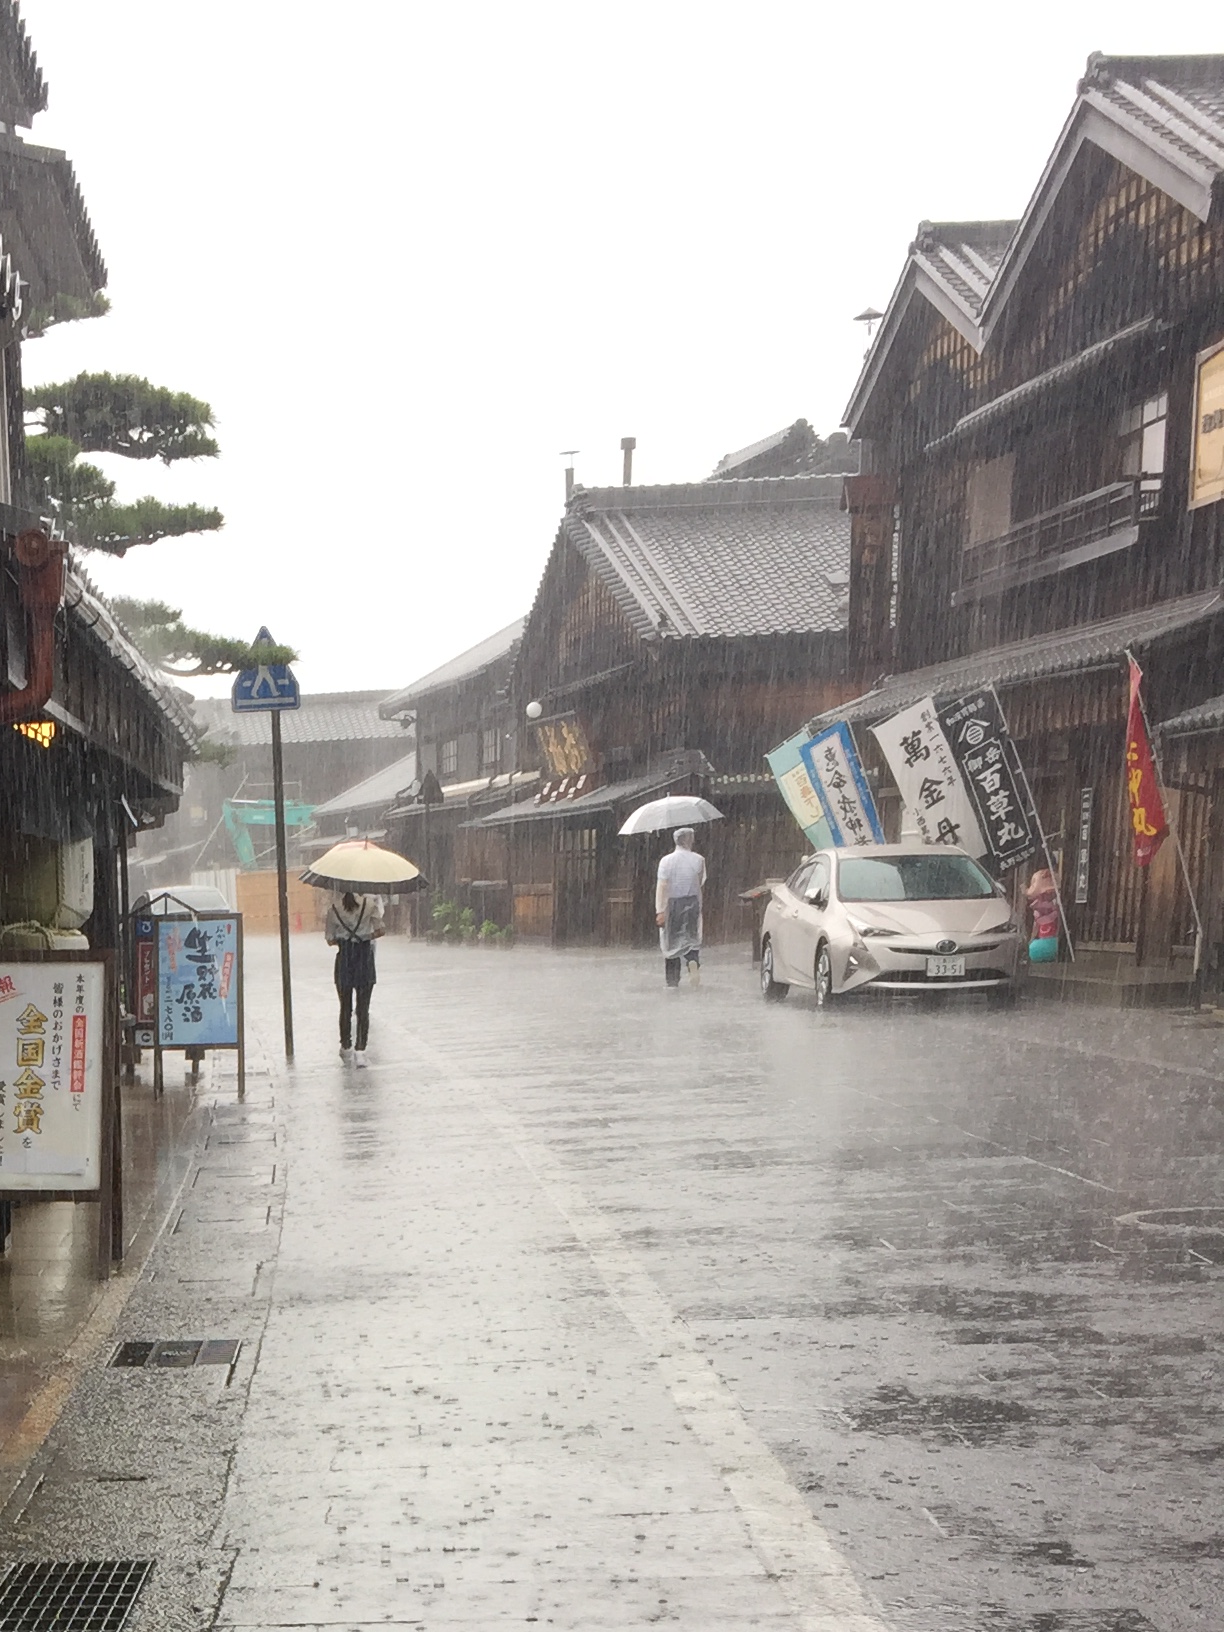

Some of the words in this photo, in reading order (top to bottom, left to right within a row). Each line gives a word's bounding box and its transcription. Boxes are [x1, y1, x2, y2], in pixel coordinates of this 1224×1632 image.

[899, 729, 960, 845] 萬金丹
[974, 763, 1025, 847] 百草丸
[50, 982, 64, 1091] 皆様のおかげさまで
